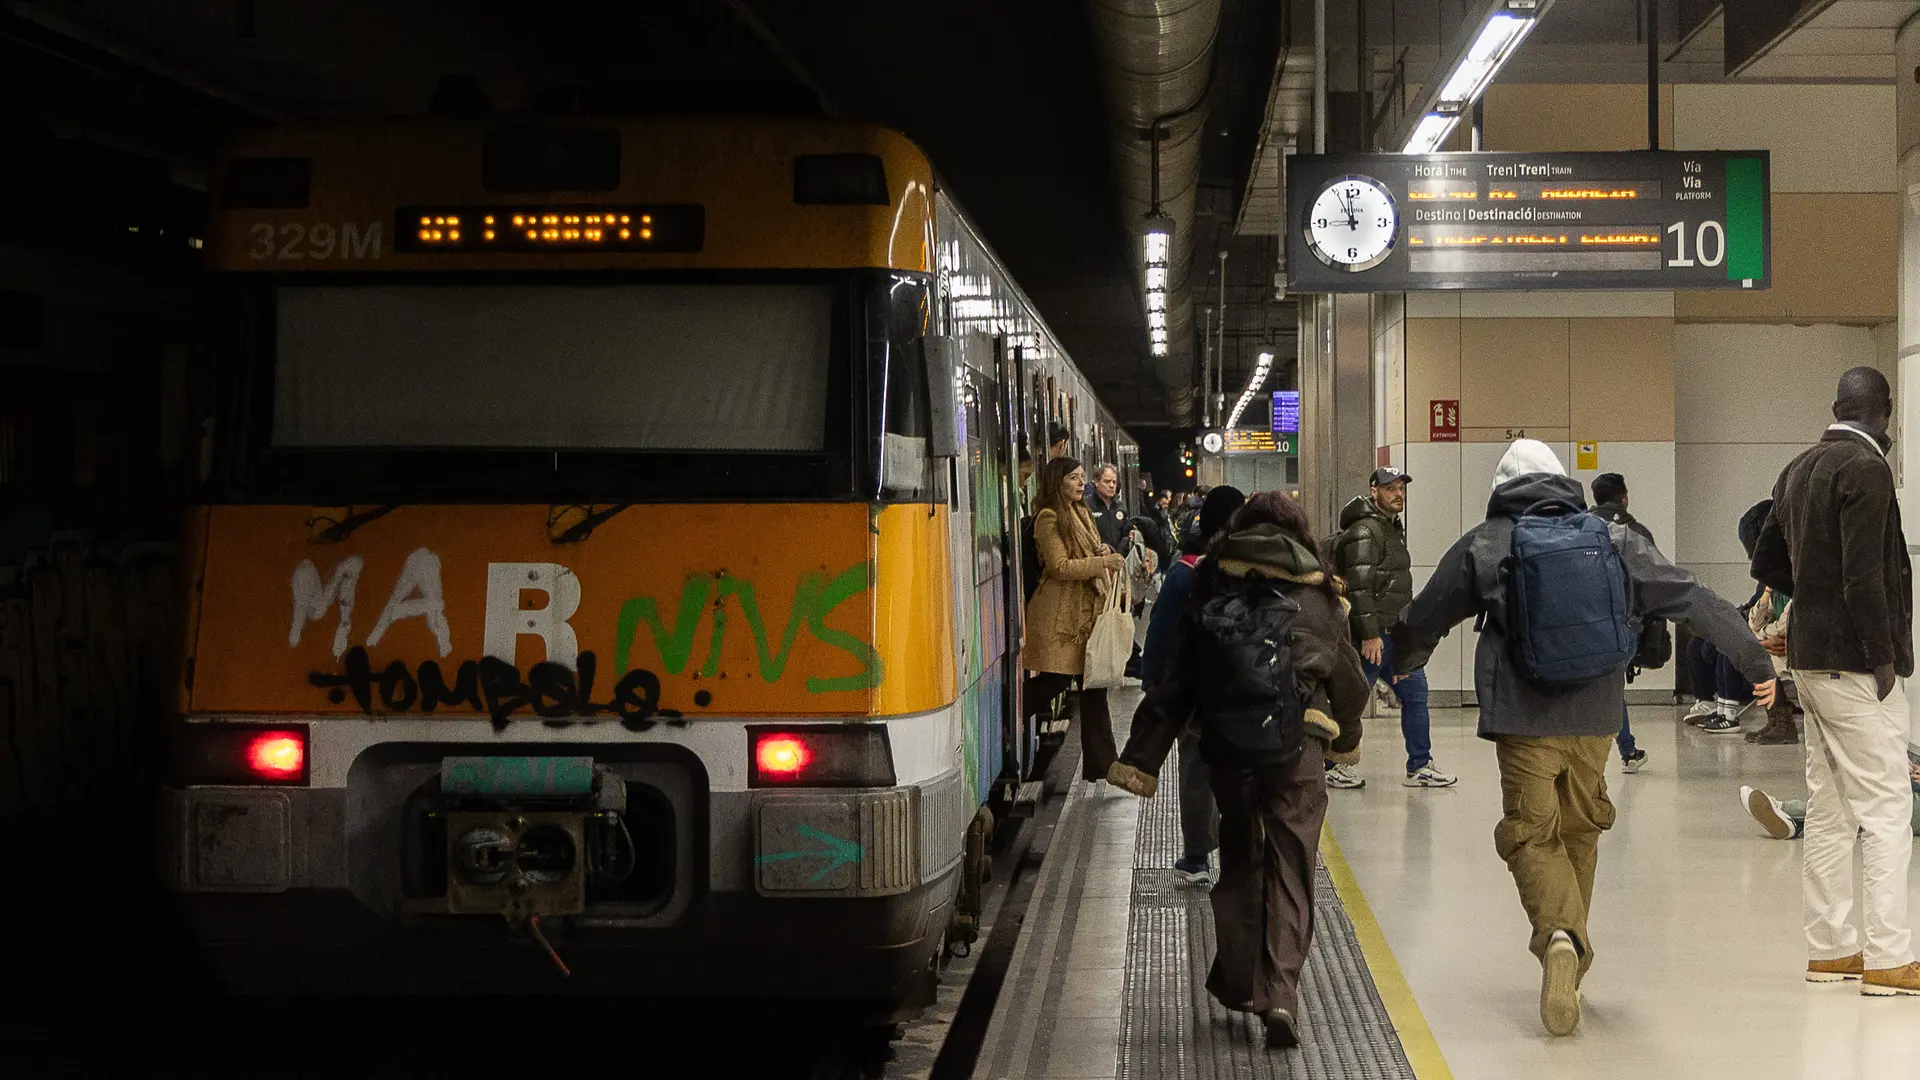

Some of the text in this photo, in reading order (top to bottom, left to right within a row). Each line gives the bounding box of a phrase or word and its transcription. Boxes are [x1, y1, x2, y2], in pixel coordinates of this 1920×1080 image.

[1415, 164, 1467, 177] Hora TIME
[1487, 163, 1572, 176] Tren Tren TRAIN
[1675, 192, 1712, 201] PLATFORM
[1416, 206, 1582, 221] Destino Destinació DESTINATION
[248, 221, 381, 261] 329M
[1667, 220, 1725, 267] 10
[1276, 441, 1290, 453] 10
